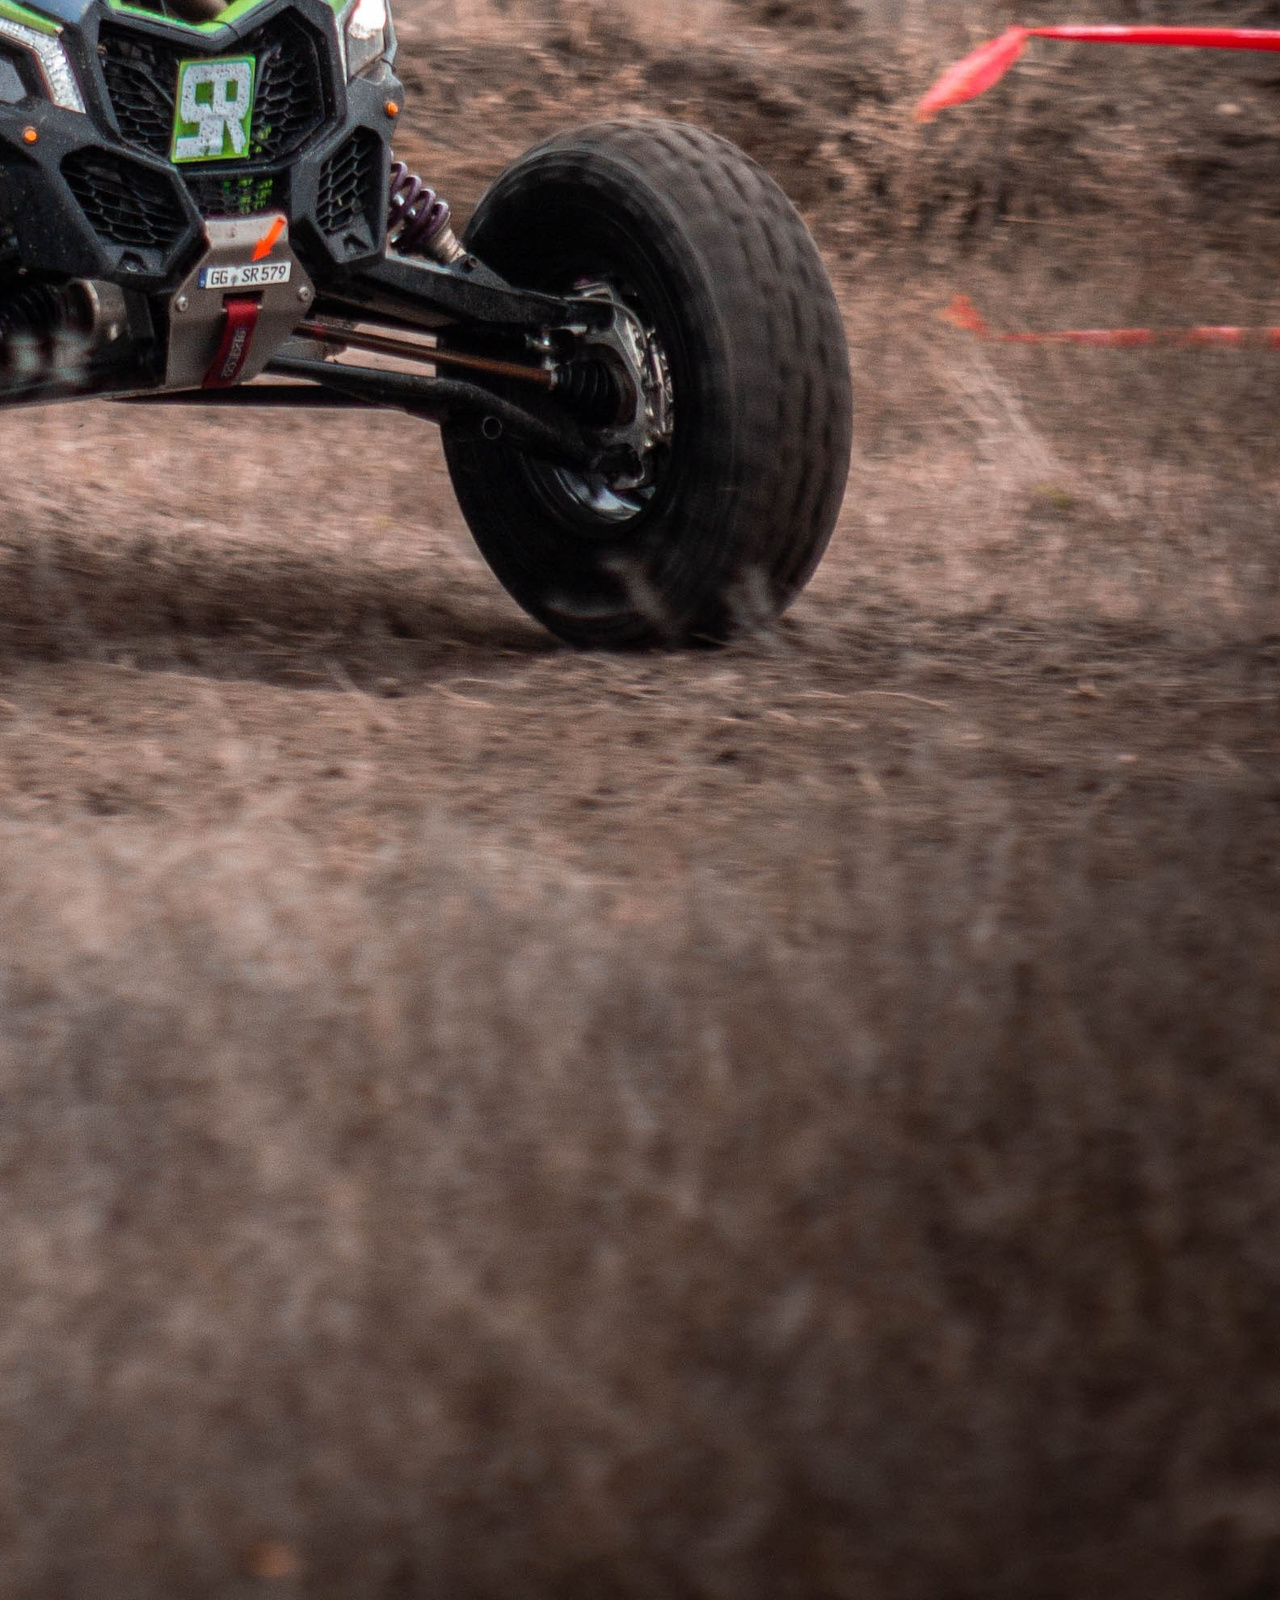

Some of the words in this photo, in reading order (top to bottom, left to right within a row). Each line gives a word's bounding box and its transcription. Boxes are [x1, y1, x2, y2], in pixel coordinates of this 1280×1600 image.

[210, 270, 228, 285] GG
[241, 267, 259, 282] SR
[261, 265, 287, 281] 579
